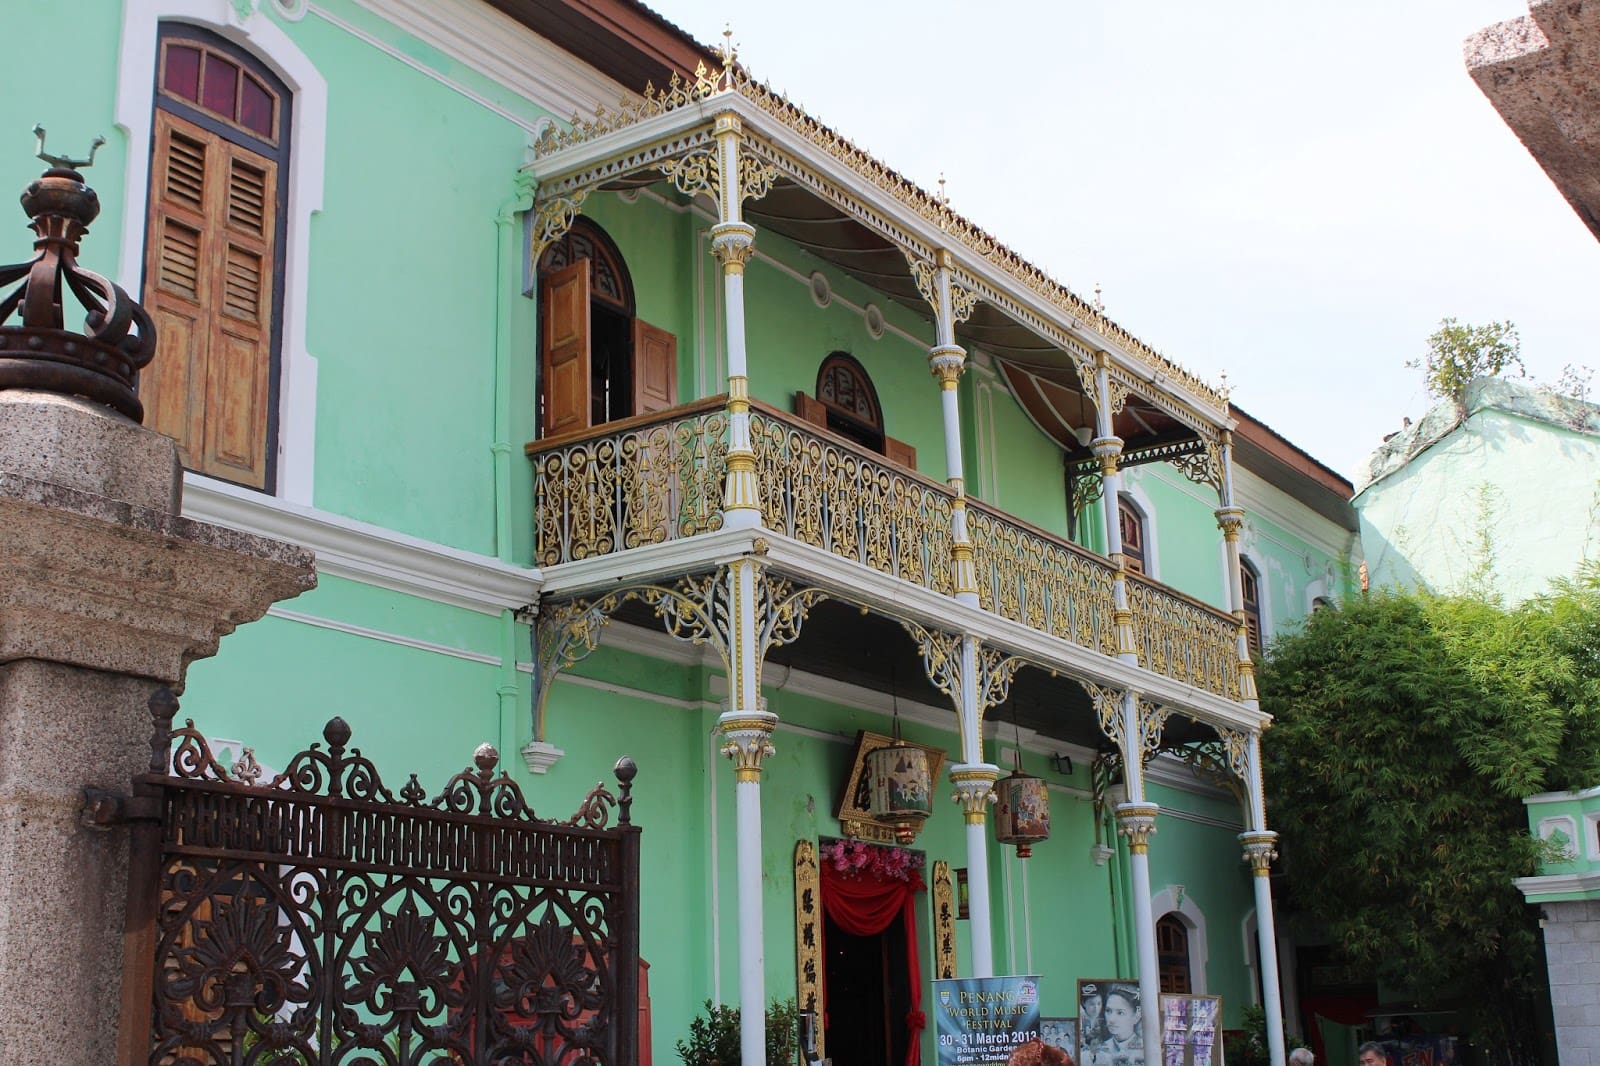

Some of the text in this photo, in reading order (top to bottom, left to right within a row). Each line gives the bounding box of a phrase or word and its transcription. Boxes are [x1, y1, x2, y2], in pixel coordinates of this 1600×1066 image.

[960, 991, 1015, 1004] PENANG
[949, 1005, 1028, 1017] WORLD MUSIC
[966, 1020, 1013, 1030] FESTIVAL
[940, 1034, 953, 1046] 30
[961, 1033, 973, 1045] 31
[976, 1032, 1009, 1044] March
[1011, 1030, 1037, 1043] 2013
[957, 1046, 987, 1054] Botanic
[957, 1055, 974, 1063] 6pm
